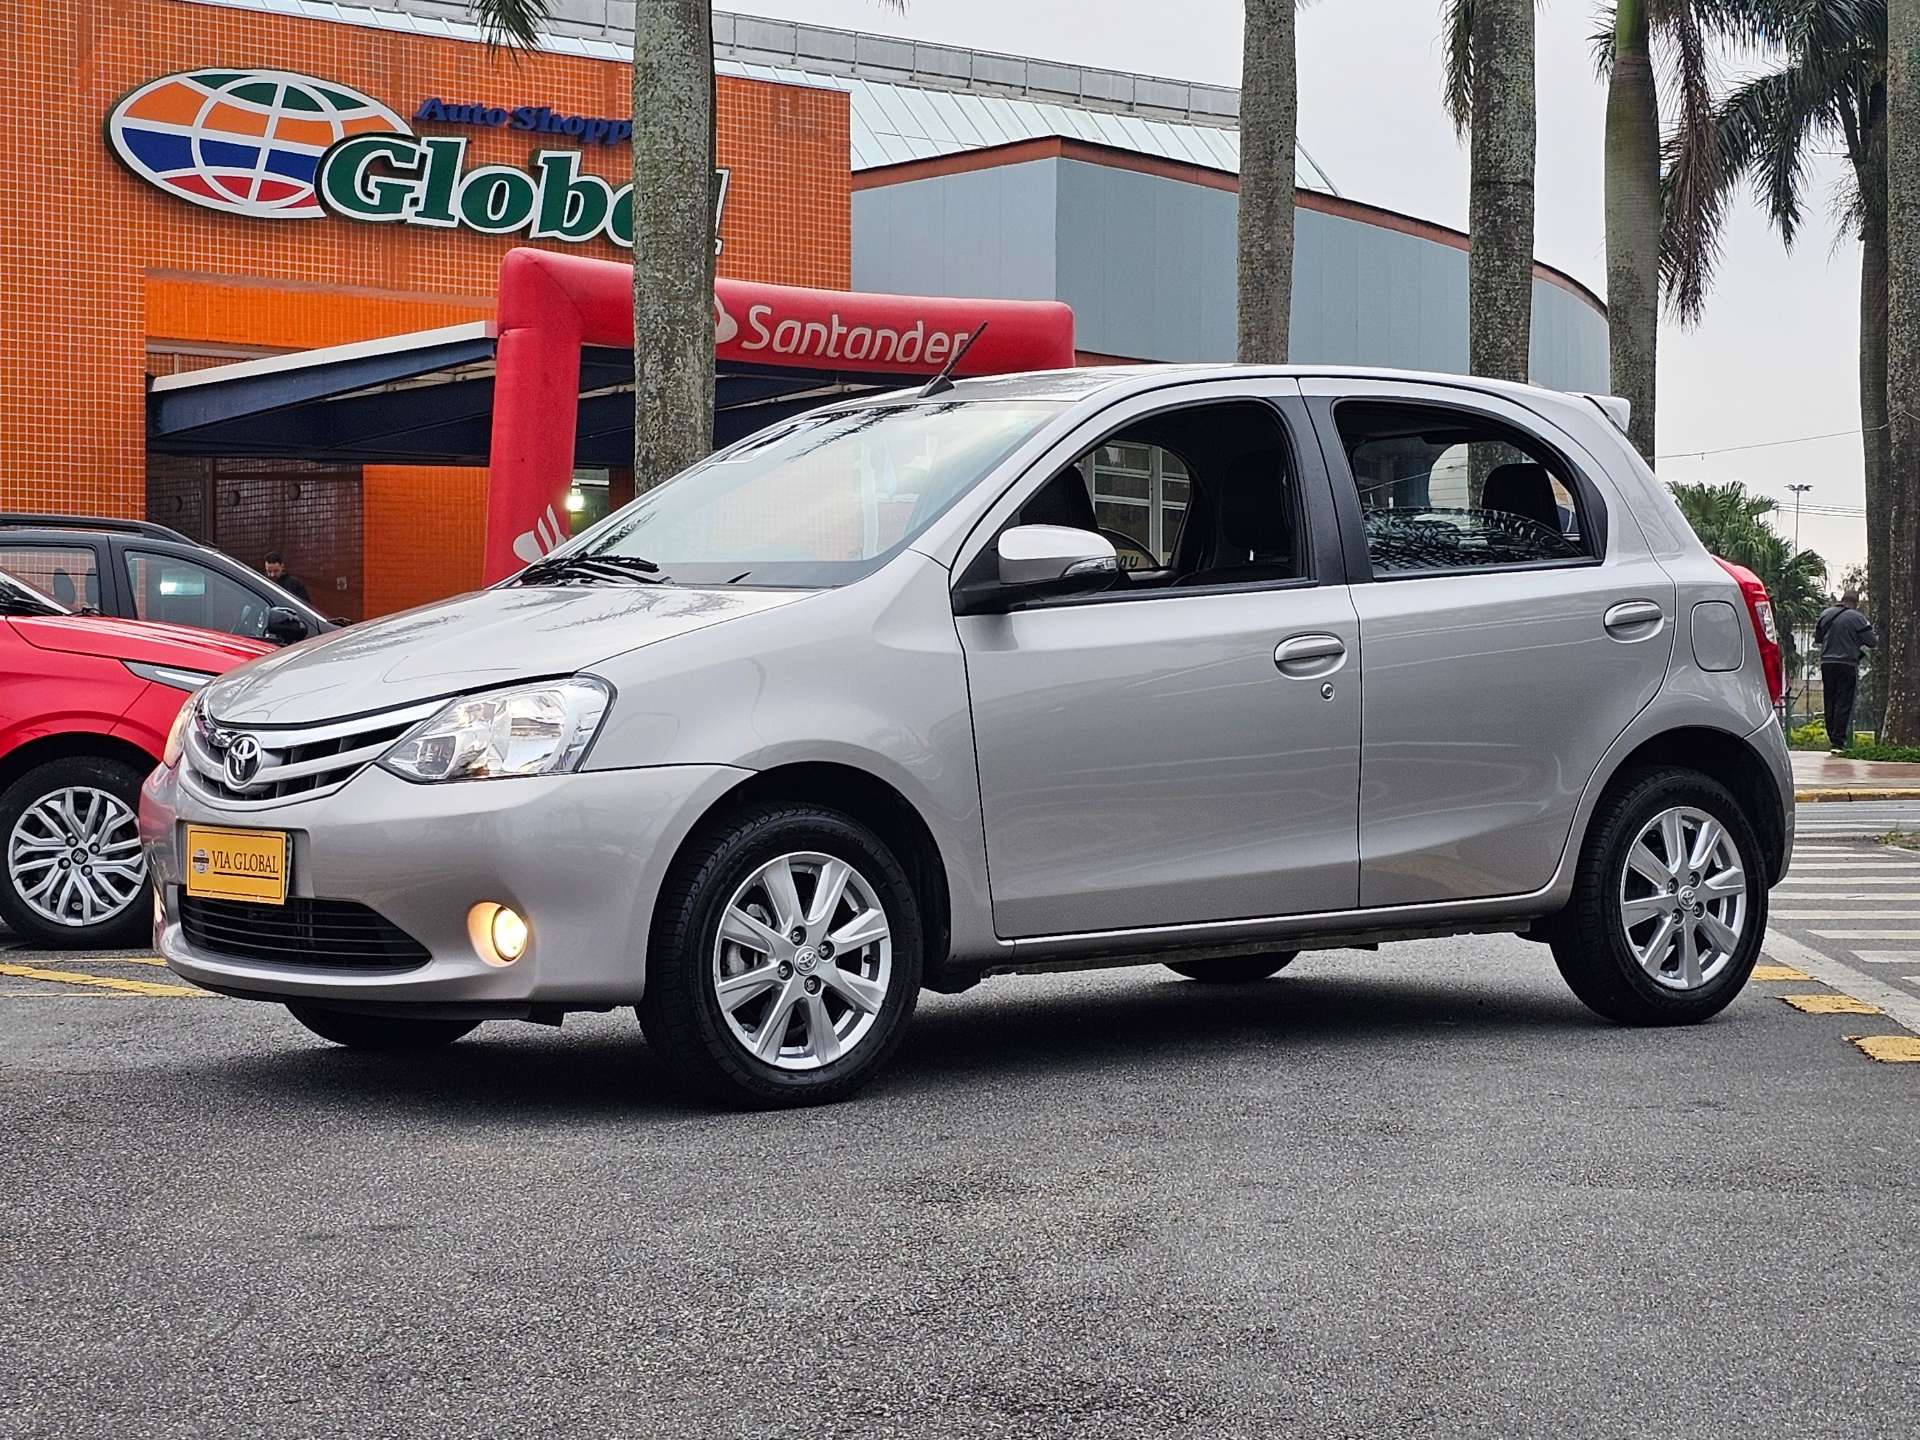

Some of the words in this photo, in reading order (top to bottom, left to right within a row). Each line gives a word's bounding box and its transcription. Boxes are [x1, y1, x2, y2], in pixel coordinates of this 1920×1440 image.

[413, 97, 508, 128] Auto
[510, 106, 634, 145] Shopp
[321, 136, 729, 255] Glob
[741, 304, 968, 364] Santander
[212, 850, 231, 869] VIA
[233, 852, 279, 873] GLOBAL
